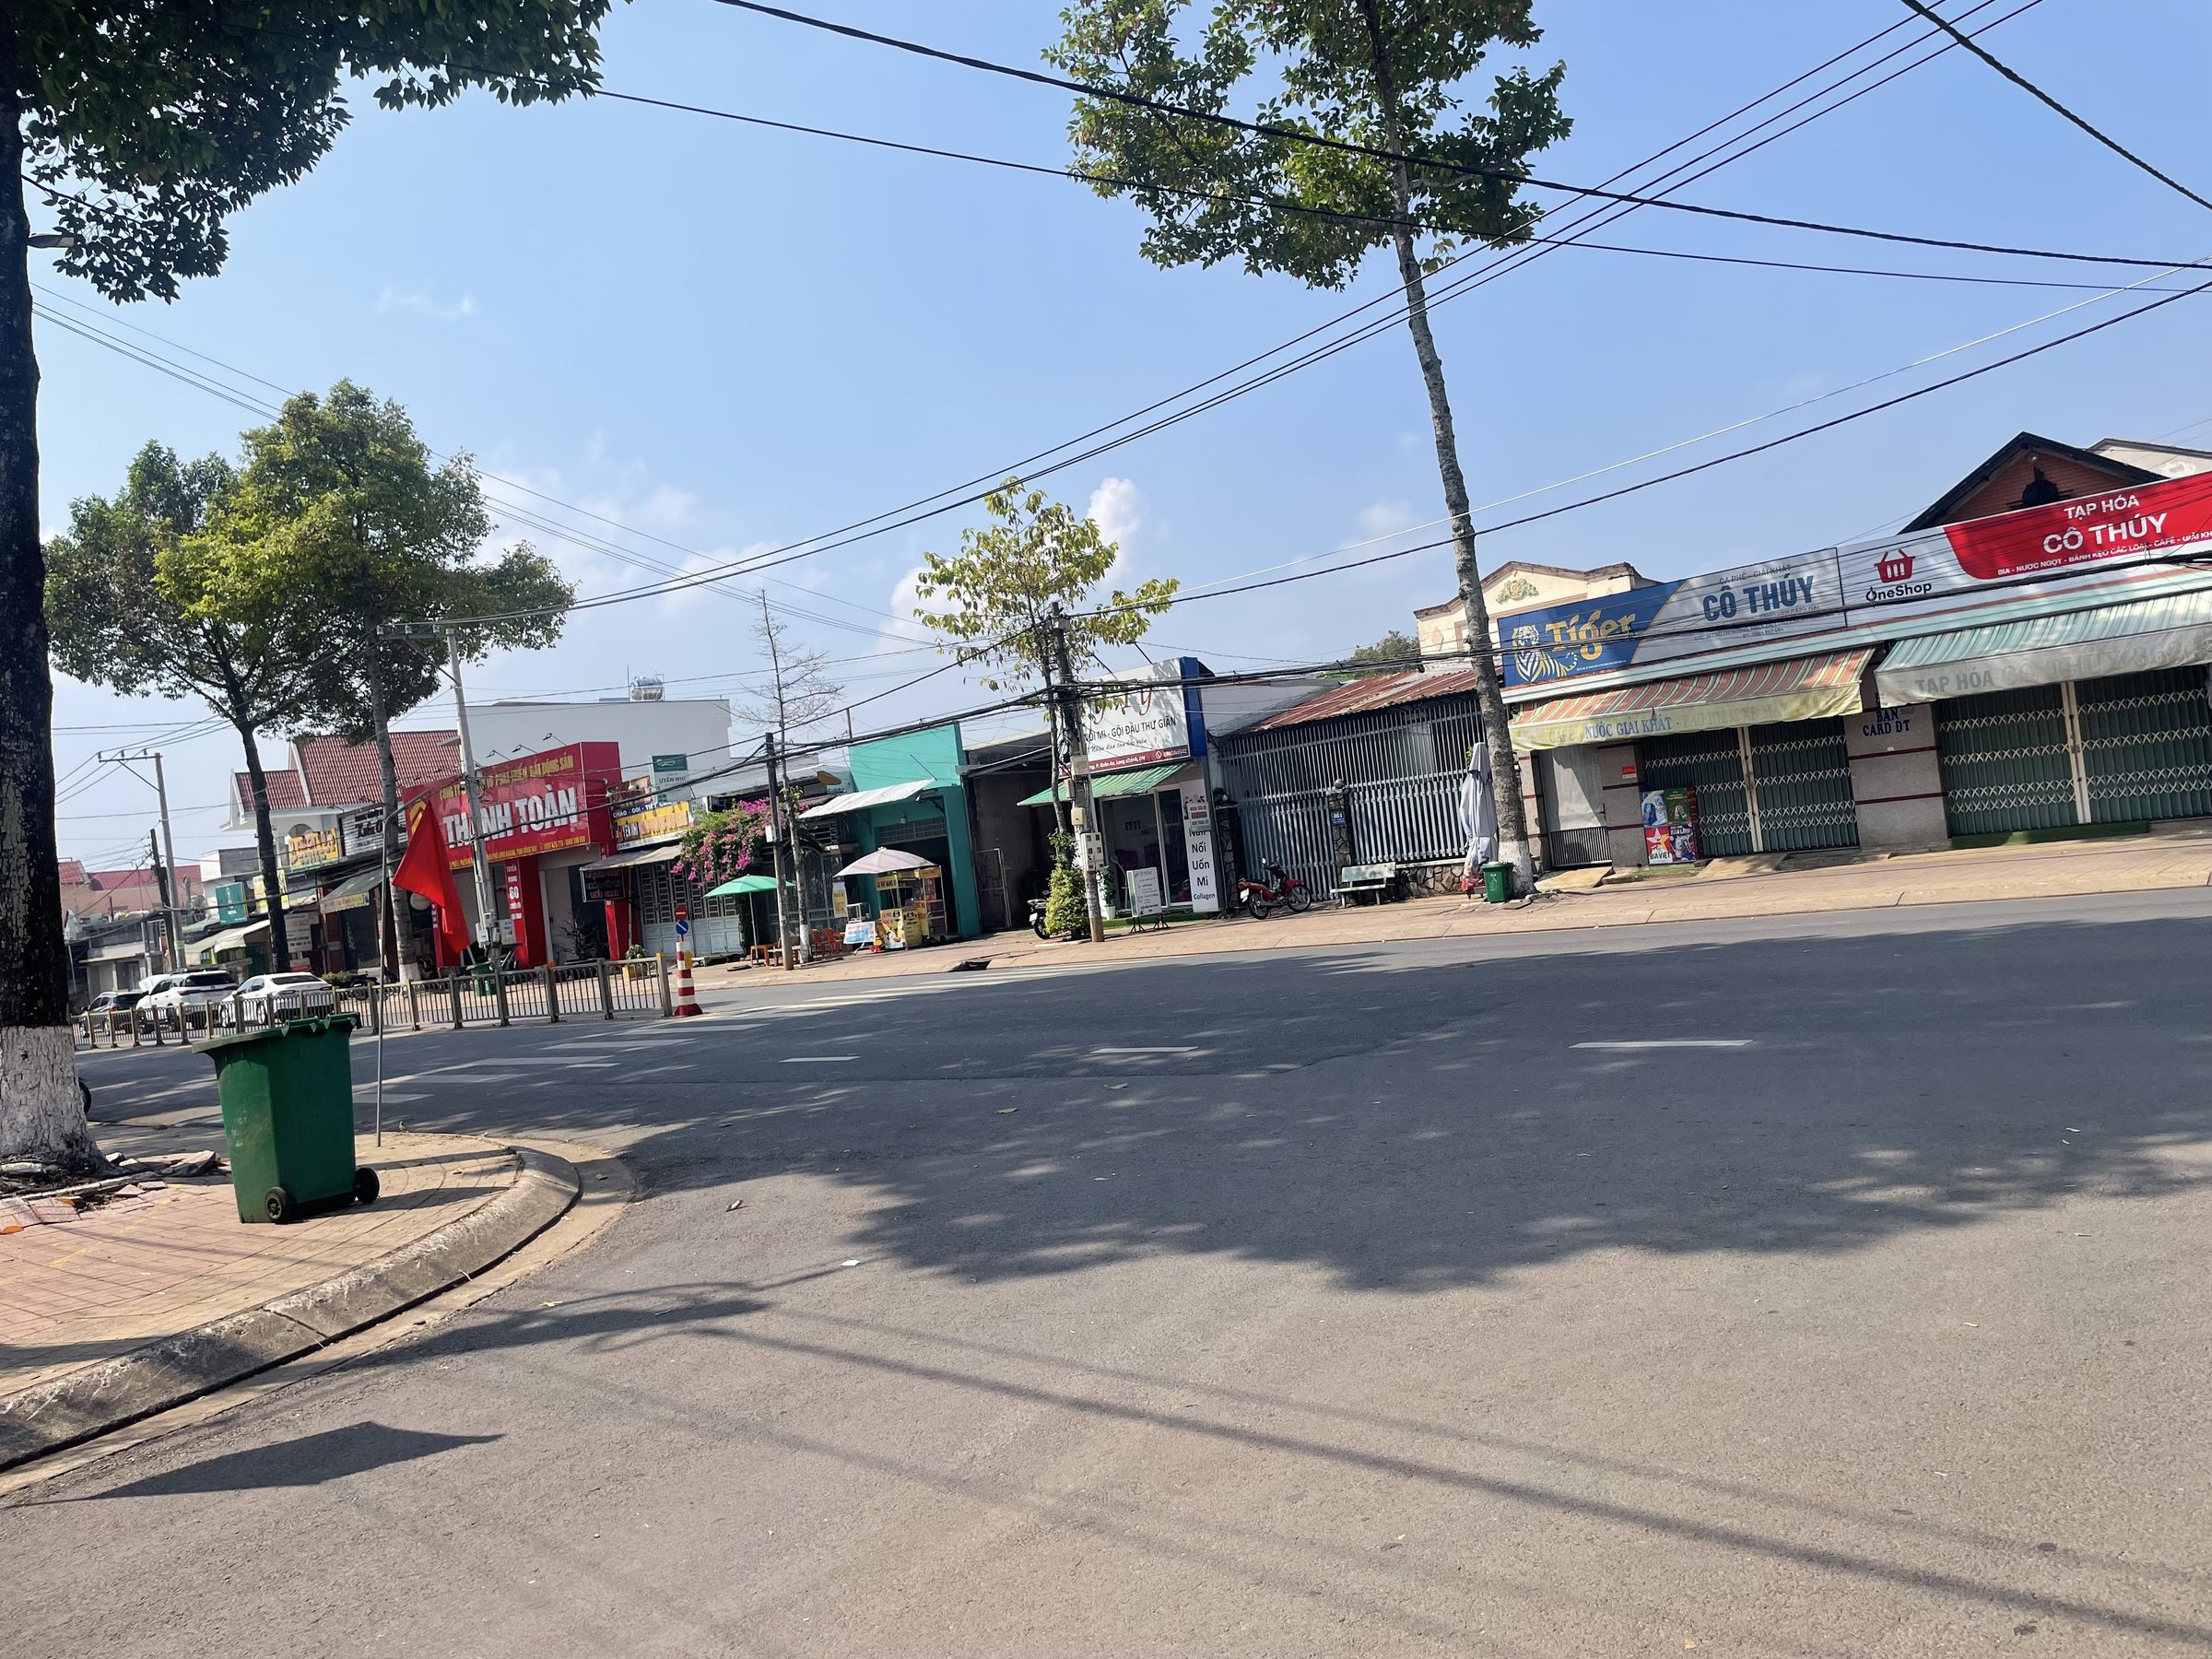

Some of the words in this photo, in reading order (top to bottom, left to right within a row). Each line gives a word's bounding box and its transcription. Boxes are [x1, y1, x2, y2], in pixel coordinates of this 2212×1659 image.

[2064, 502, 2097, 521] TẠP
[2101, 494, 2140, 513] HÓA
[2043, 527, 2084, 554] CÔ
[2088, 512, 2168, 546] THÚY
[1997, 568, 2011, 576] BIA
[1702, 585, 1737, 622] CÔ
[1742, 572, 1814, 615] THÚY
[1865, 581, 1933, 603] OneShop
[1545, 608, 1636, 661] Tiger
[1584, 721, 1614, 740] NƯỚC
[1617, 716, 1640, 736] GIẢI
[1641, 711, 1673, 734] KHÁT
[1862, 722, 1892, 737] CARD
[442, 802, 514, 850] THNH
[514, 783, 580, 834] TOÀN
[1191, 841, 1206, 853] Nối
[1192, 858, 1210, 870] Uốn
[1196, 877, 1209, 887] Mi
[509, 886, 520, 900] 60
[1194, 892, 1216, 900] Collagen
